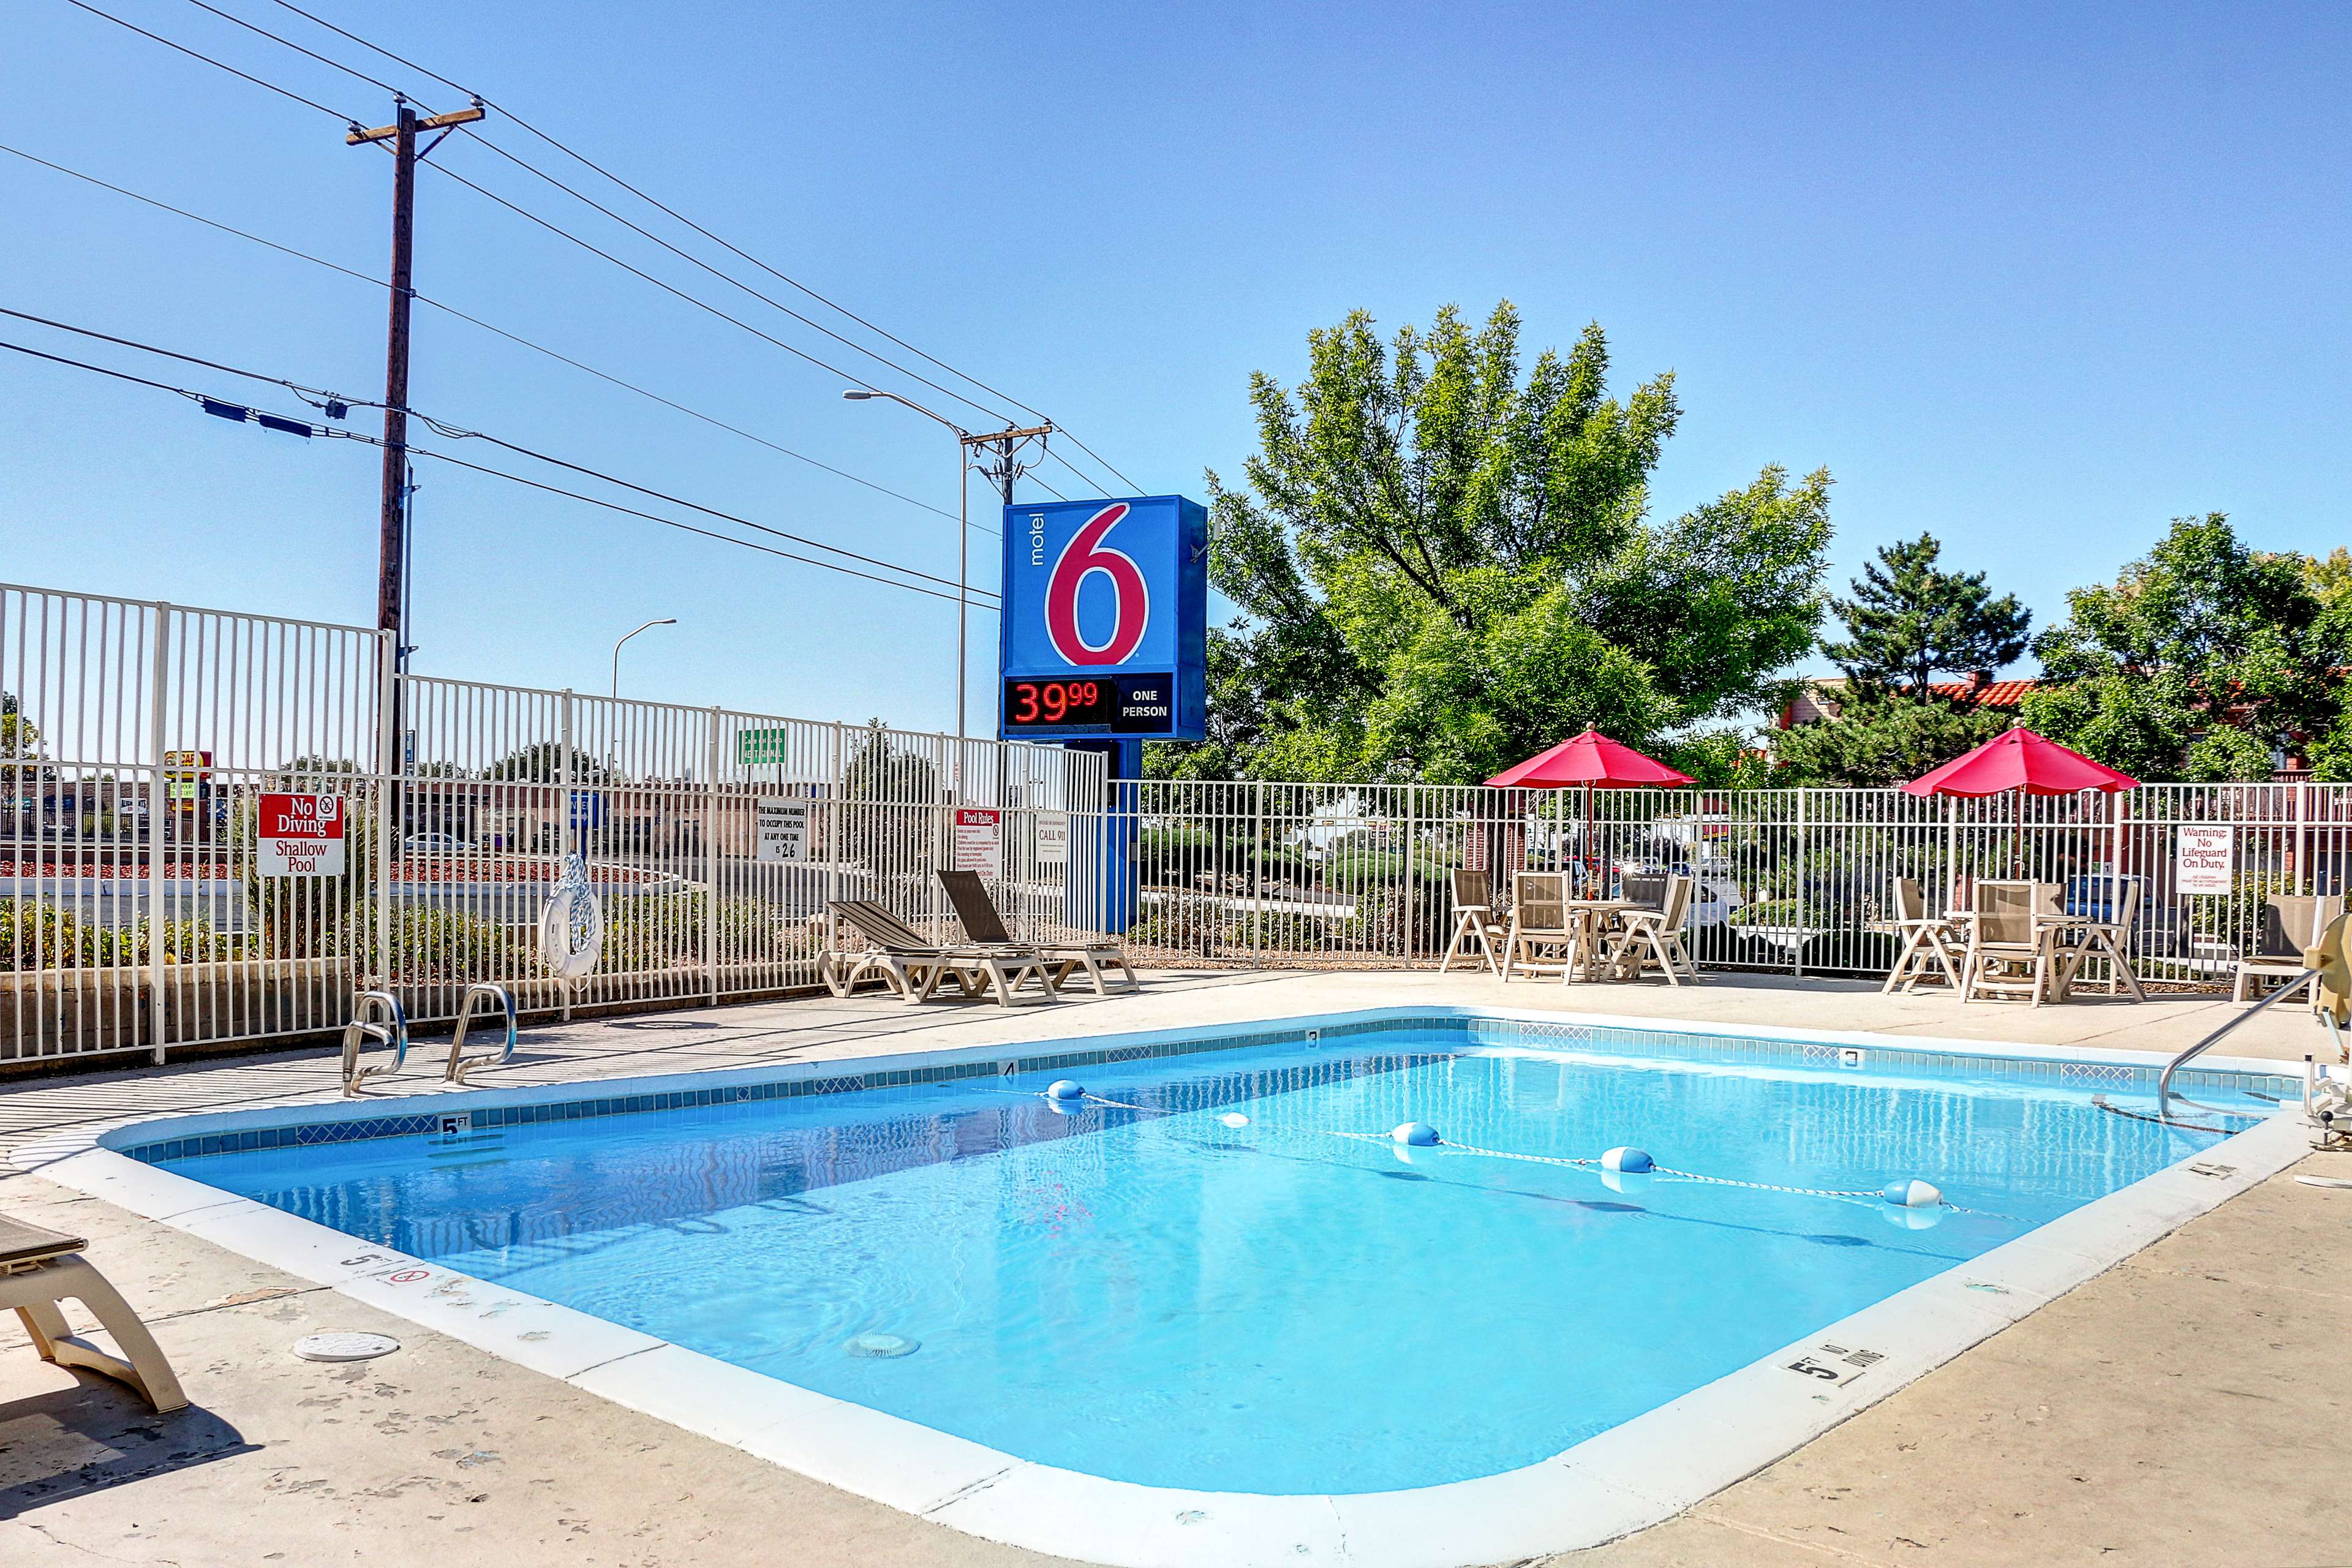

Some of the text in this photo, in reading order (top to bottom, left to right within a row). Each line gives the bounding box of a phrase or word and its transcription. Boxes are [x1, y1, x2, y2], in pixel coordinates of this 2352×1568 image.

[1029, 513, 1044, 566] motel
[1044, 502, 1149, 666] 6
[1133, 691, 1157, 701] ONE
[1123, 706, 1167, 717] PERSON
[291, 797, 313, 815] No
[767, 807, 788, 815] MAXIMUM
[788, 807, 805, 816] NUMBER
[963, 812, 993, 824] Pool Rules
[277, 814, 326, 837] Diving
[1039, 829, 1056, 840] CALL
[2183, 827, 2226, 839] Warning:
[276, 840, 328, 856] Shallow
[2198, 838, 2212, 847] No
[782, 843, 795, 858] 26
[2182, 848, 2226, 859] Lifeguard
[287, 857, 316, 872] Pool
[2183, 858, 2225, 870] On Duty.
[442, 1117, 468, 1135] 5 FT
[1819, 1344, 1849, 1355] NO
[1841, 1349, 1885, 1368] DIVING
[1787, 1357, 1839, 1380] 5 FT
